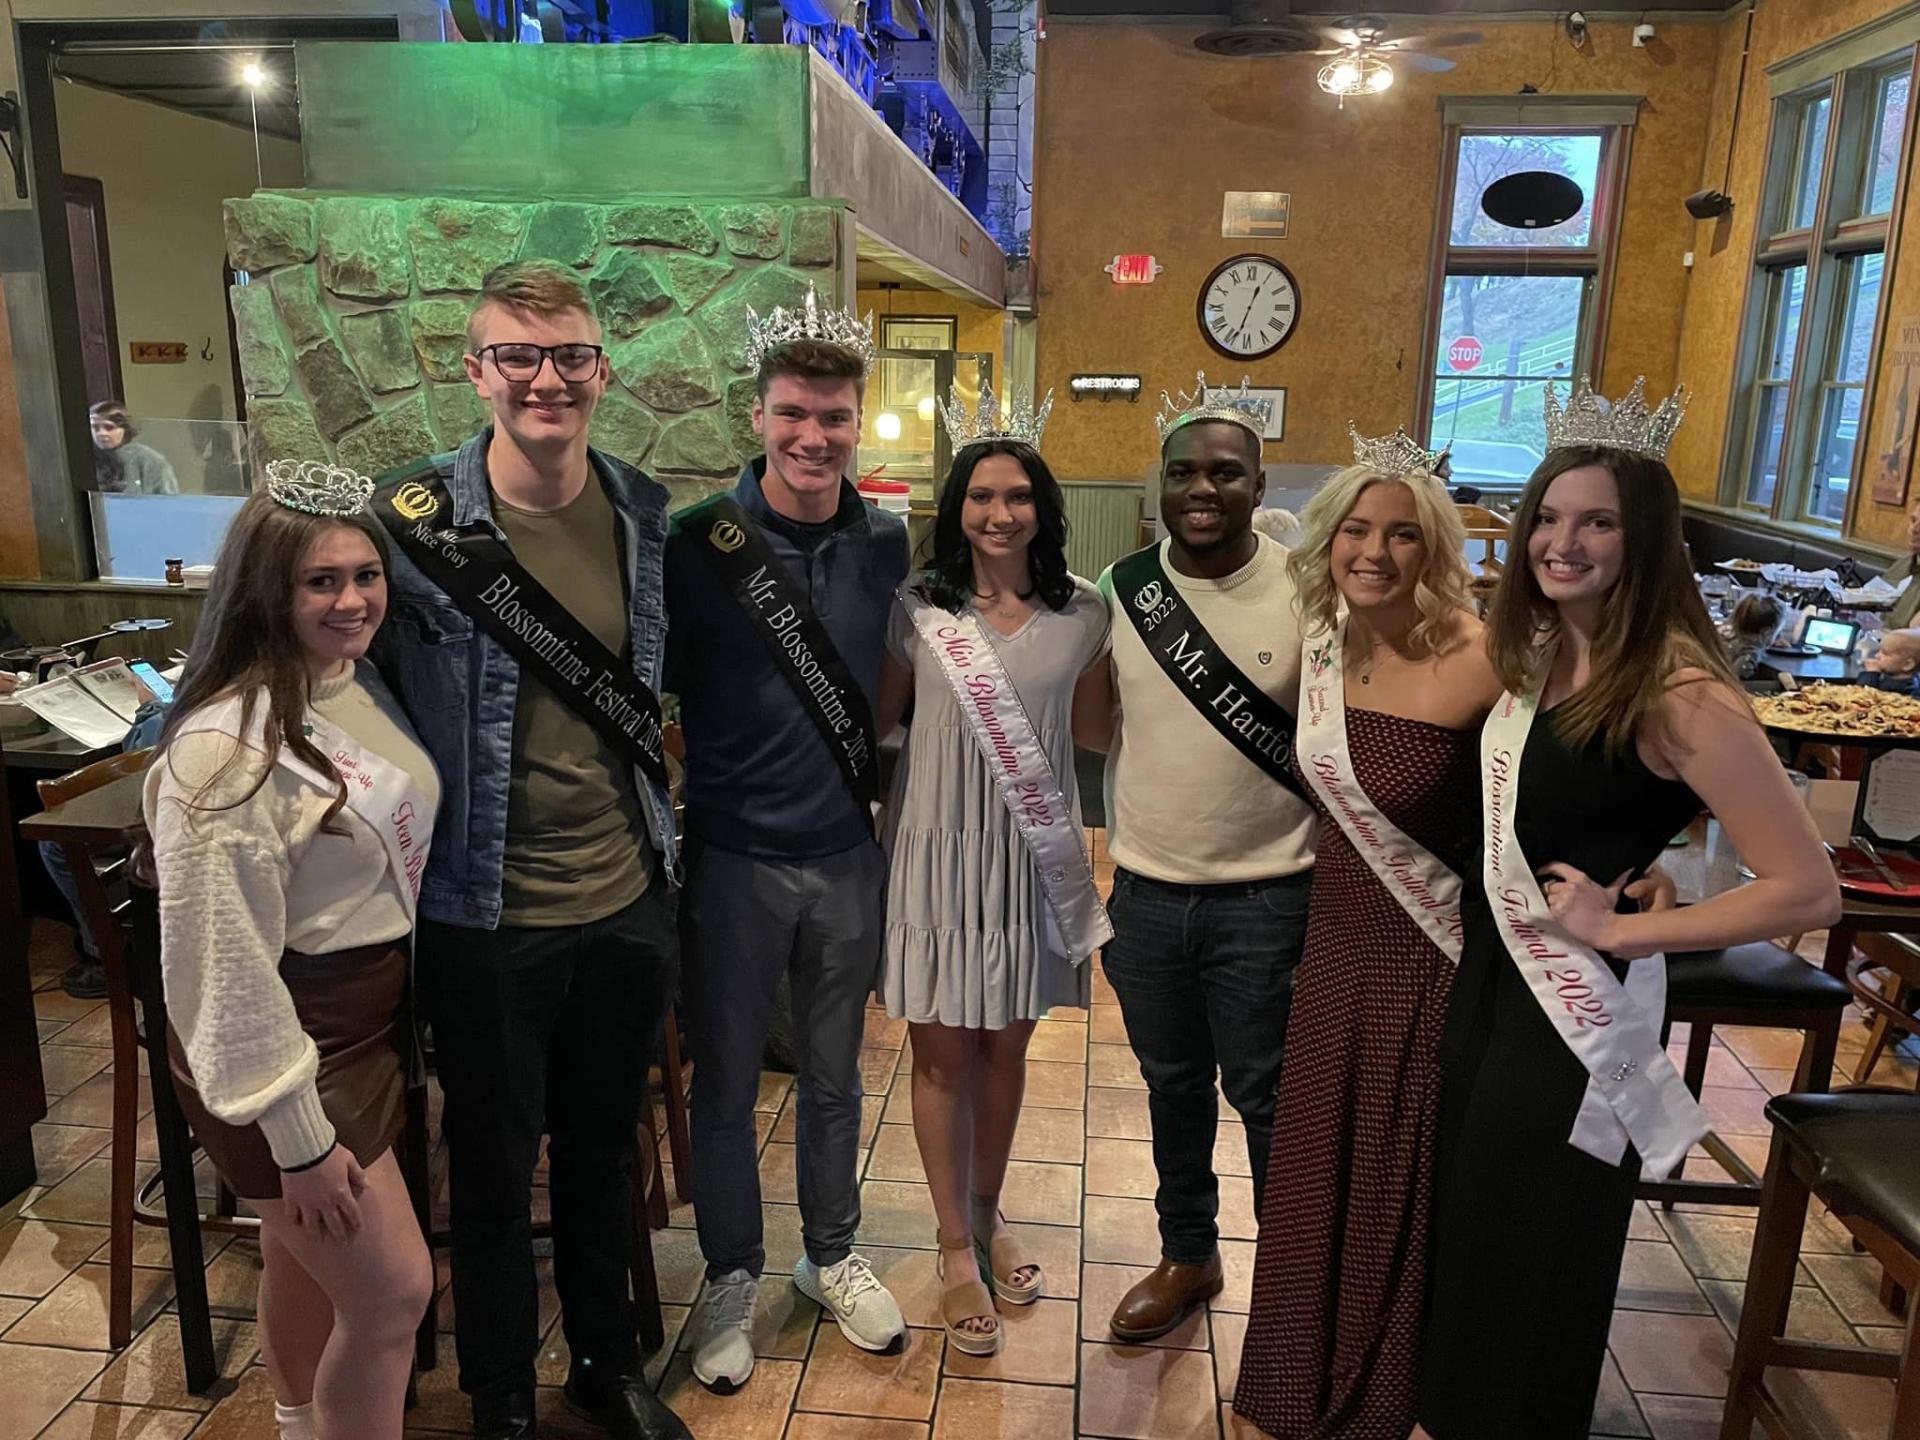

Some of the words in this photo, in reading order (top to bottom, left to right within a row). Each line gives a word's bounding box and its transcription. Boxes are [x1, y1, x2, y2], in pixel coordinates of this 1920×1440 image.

[1119, 256, 1149, 281] EXIT
[1081, 377, 1140, 389] RESTROOMS
[1450, 347, 1481, 361] STOP
[411, 521, 438, 549] Nice
[442, 543, 469, 569] Guy
[741, 564, 776, 609] Mr.
[766, 603, 852, 734] Blossomtime
[1144, 596, 1177, 631] 2022
[477, 572, 590, 686] Blossomtime
[584, 669, 649, 738] Festival
[937, 626, 972, 668] Miss
[963, 674, 1023, 777] Blossomtime
[1014, 782, 1055, 828] 2022
[1164, 630, 1208, 689] Mr.
[1209, 682, 1290, 773] Hartfo
[1311, 754, 1385, 849] Blossomtime
[1381, 853, 1453, 911] Festival
[1491, 748, 1512, 879] Blossomtime
[1497, 886, 1568, 962] Festival
[1545, 969, 1613, 1028] 2022
